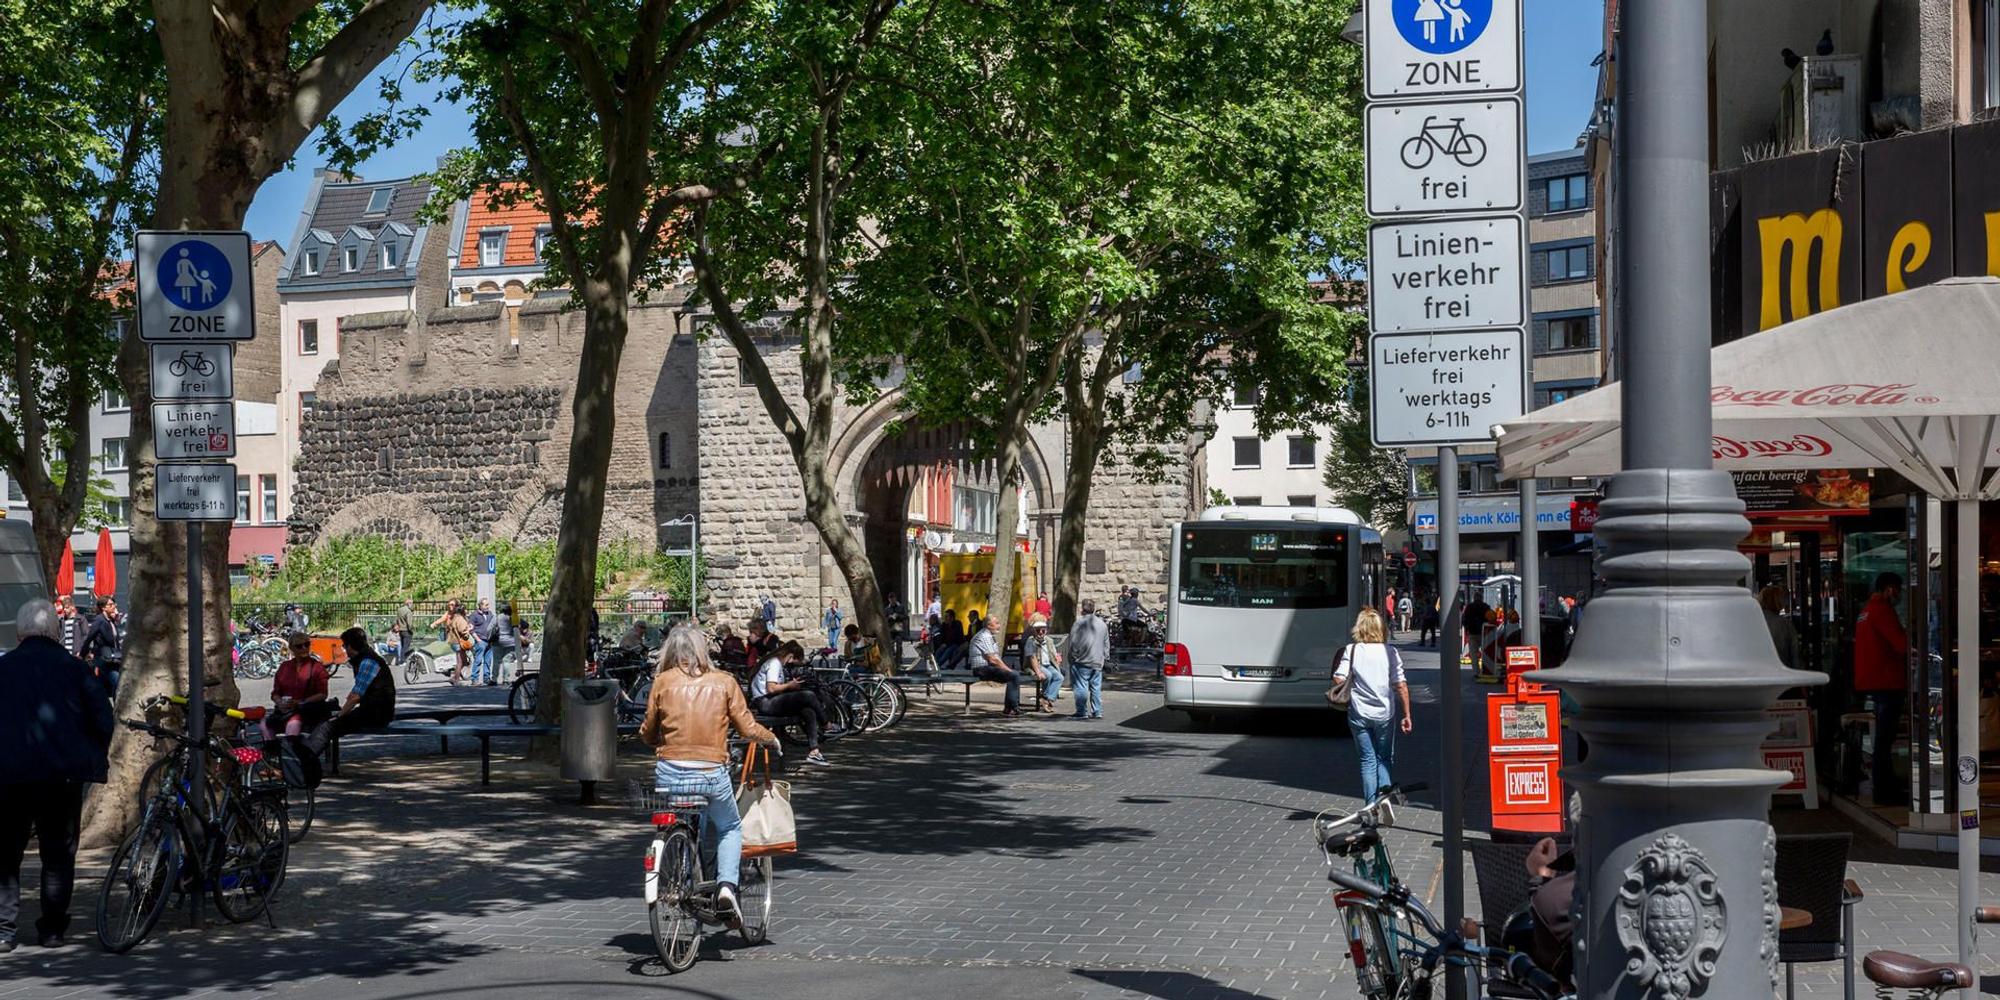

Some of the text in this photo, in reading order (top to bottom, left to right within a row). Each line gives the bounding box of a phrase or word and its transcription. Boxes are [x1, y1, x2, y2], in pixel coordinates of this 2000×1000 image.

[1405, 61, 1481, 86] ZONE
[1421, 176, 1468, 200] frei
[1397, 234, 1494, 259] Linien-
[1392, 263, 1500, 289] verkehr
[1424, 294, 1470, 319] frei
[169, 316, 226, 332] ZONE
[1383, 345, 1511, 366] Lieferverkehr
[1432, 370, 1464, 384] frei
[181, 380, 206, 392] frei
[1405, 391, 1492, 410] werktags
[1711, 383, 1917, 407] oca-Cola
[167, 410, 219, 422] Linien-
[1426, 413, 1470, 428] 6-11h
[165, 425, 223, 437] verkehr
[183, 440, 208, 453] frei
[168, 473, 221, 484] Lieferverkehr
[1768, 470, 1808, 484] beerig!
[186, 487, 200, 496] frei
[163, 501, 199, 512] werktags
[1458, 513, 1493, 525] sbank
[488, 556, 495, 571] U
[955, 572, 993, 584] DH
[1509, 771, 1545, 795] EXPRESS
